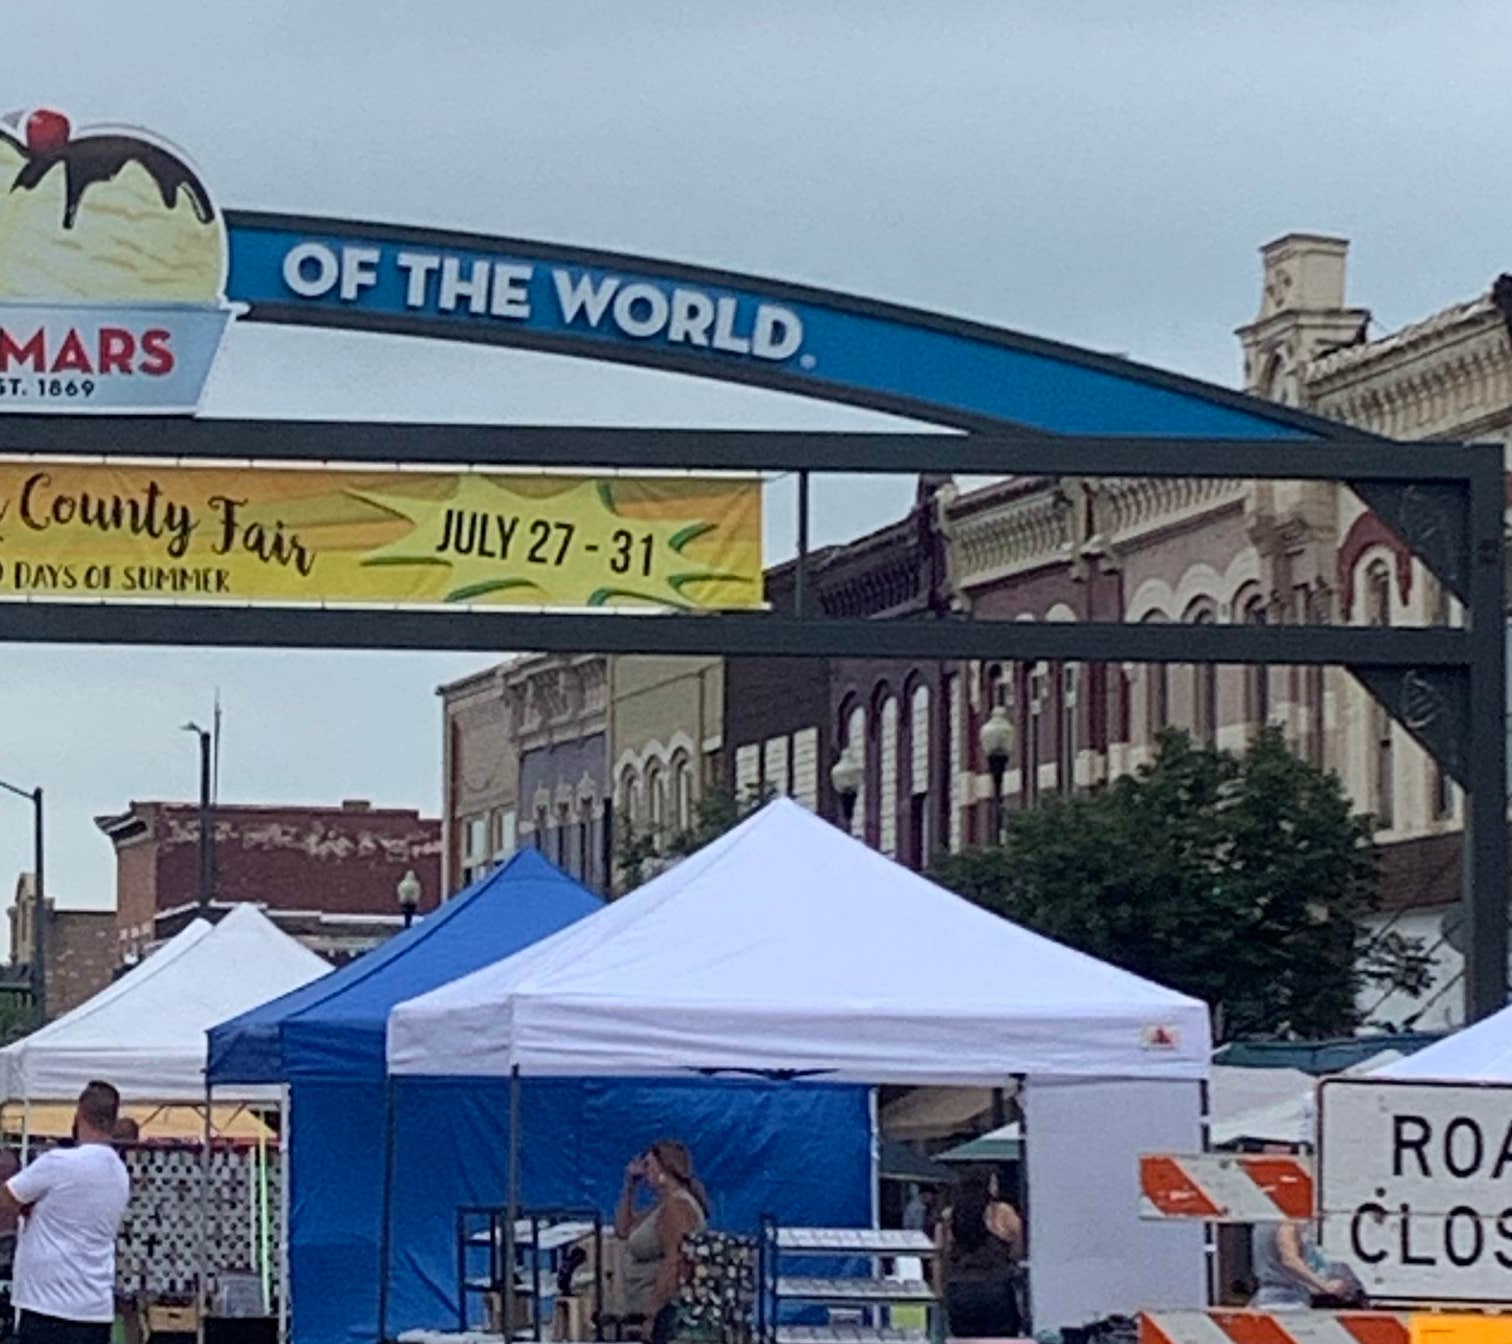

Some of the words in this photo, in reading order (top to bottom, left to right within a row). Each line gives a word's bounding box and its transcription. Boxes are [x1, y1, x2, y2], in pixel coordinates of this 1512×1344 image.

[282, 242, 381, 300] OF
[397, 251, 534, 319] THE
[38, 379, 95, 397] 1869
[20, 472, 200, 558] County
[207, 495, 315, 576] Fair
[436, 509, 520, 560] JULY
[527, 519, 576, 567] 27
[609, 528, 654, 577] 31
[14, 561, 78, 590] DAYS
[88, 564, 112, 590] OF
[123, 566, 231, 593] SUMMER
